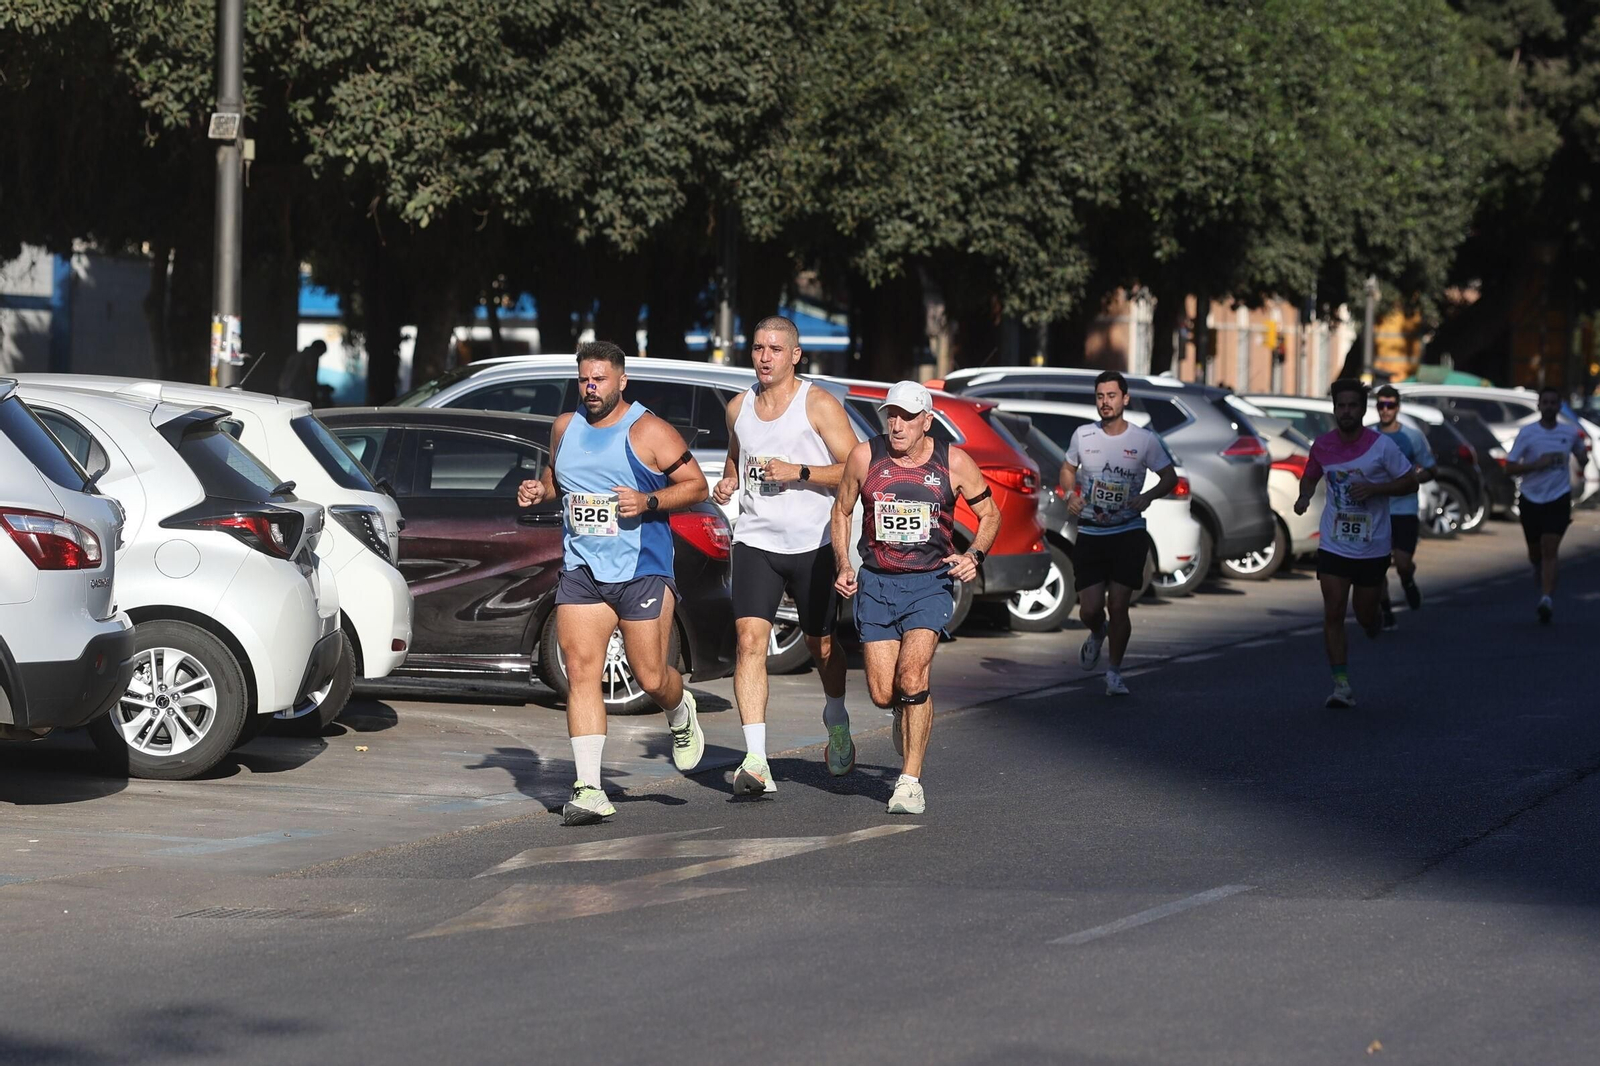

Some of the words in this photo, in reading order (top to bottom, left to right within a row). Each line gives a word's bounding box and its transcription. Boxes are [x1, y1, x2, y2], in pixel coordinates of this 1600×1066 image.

[1096, 489, 1123, 503] 326
[574, 507, 609, 523] 526
[883, 516, 921, 530] 525
[1342, 522, 1361, 534] 36
